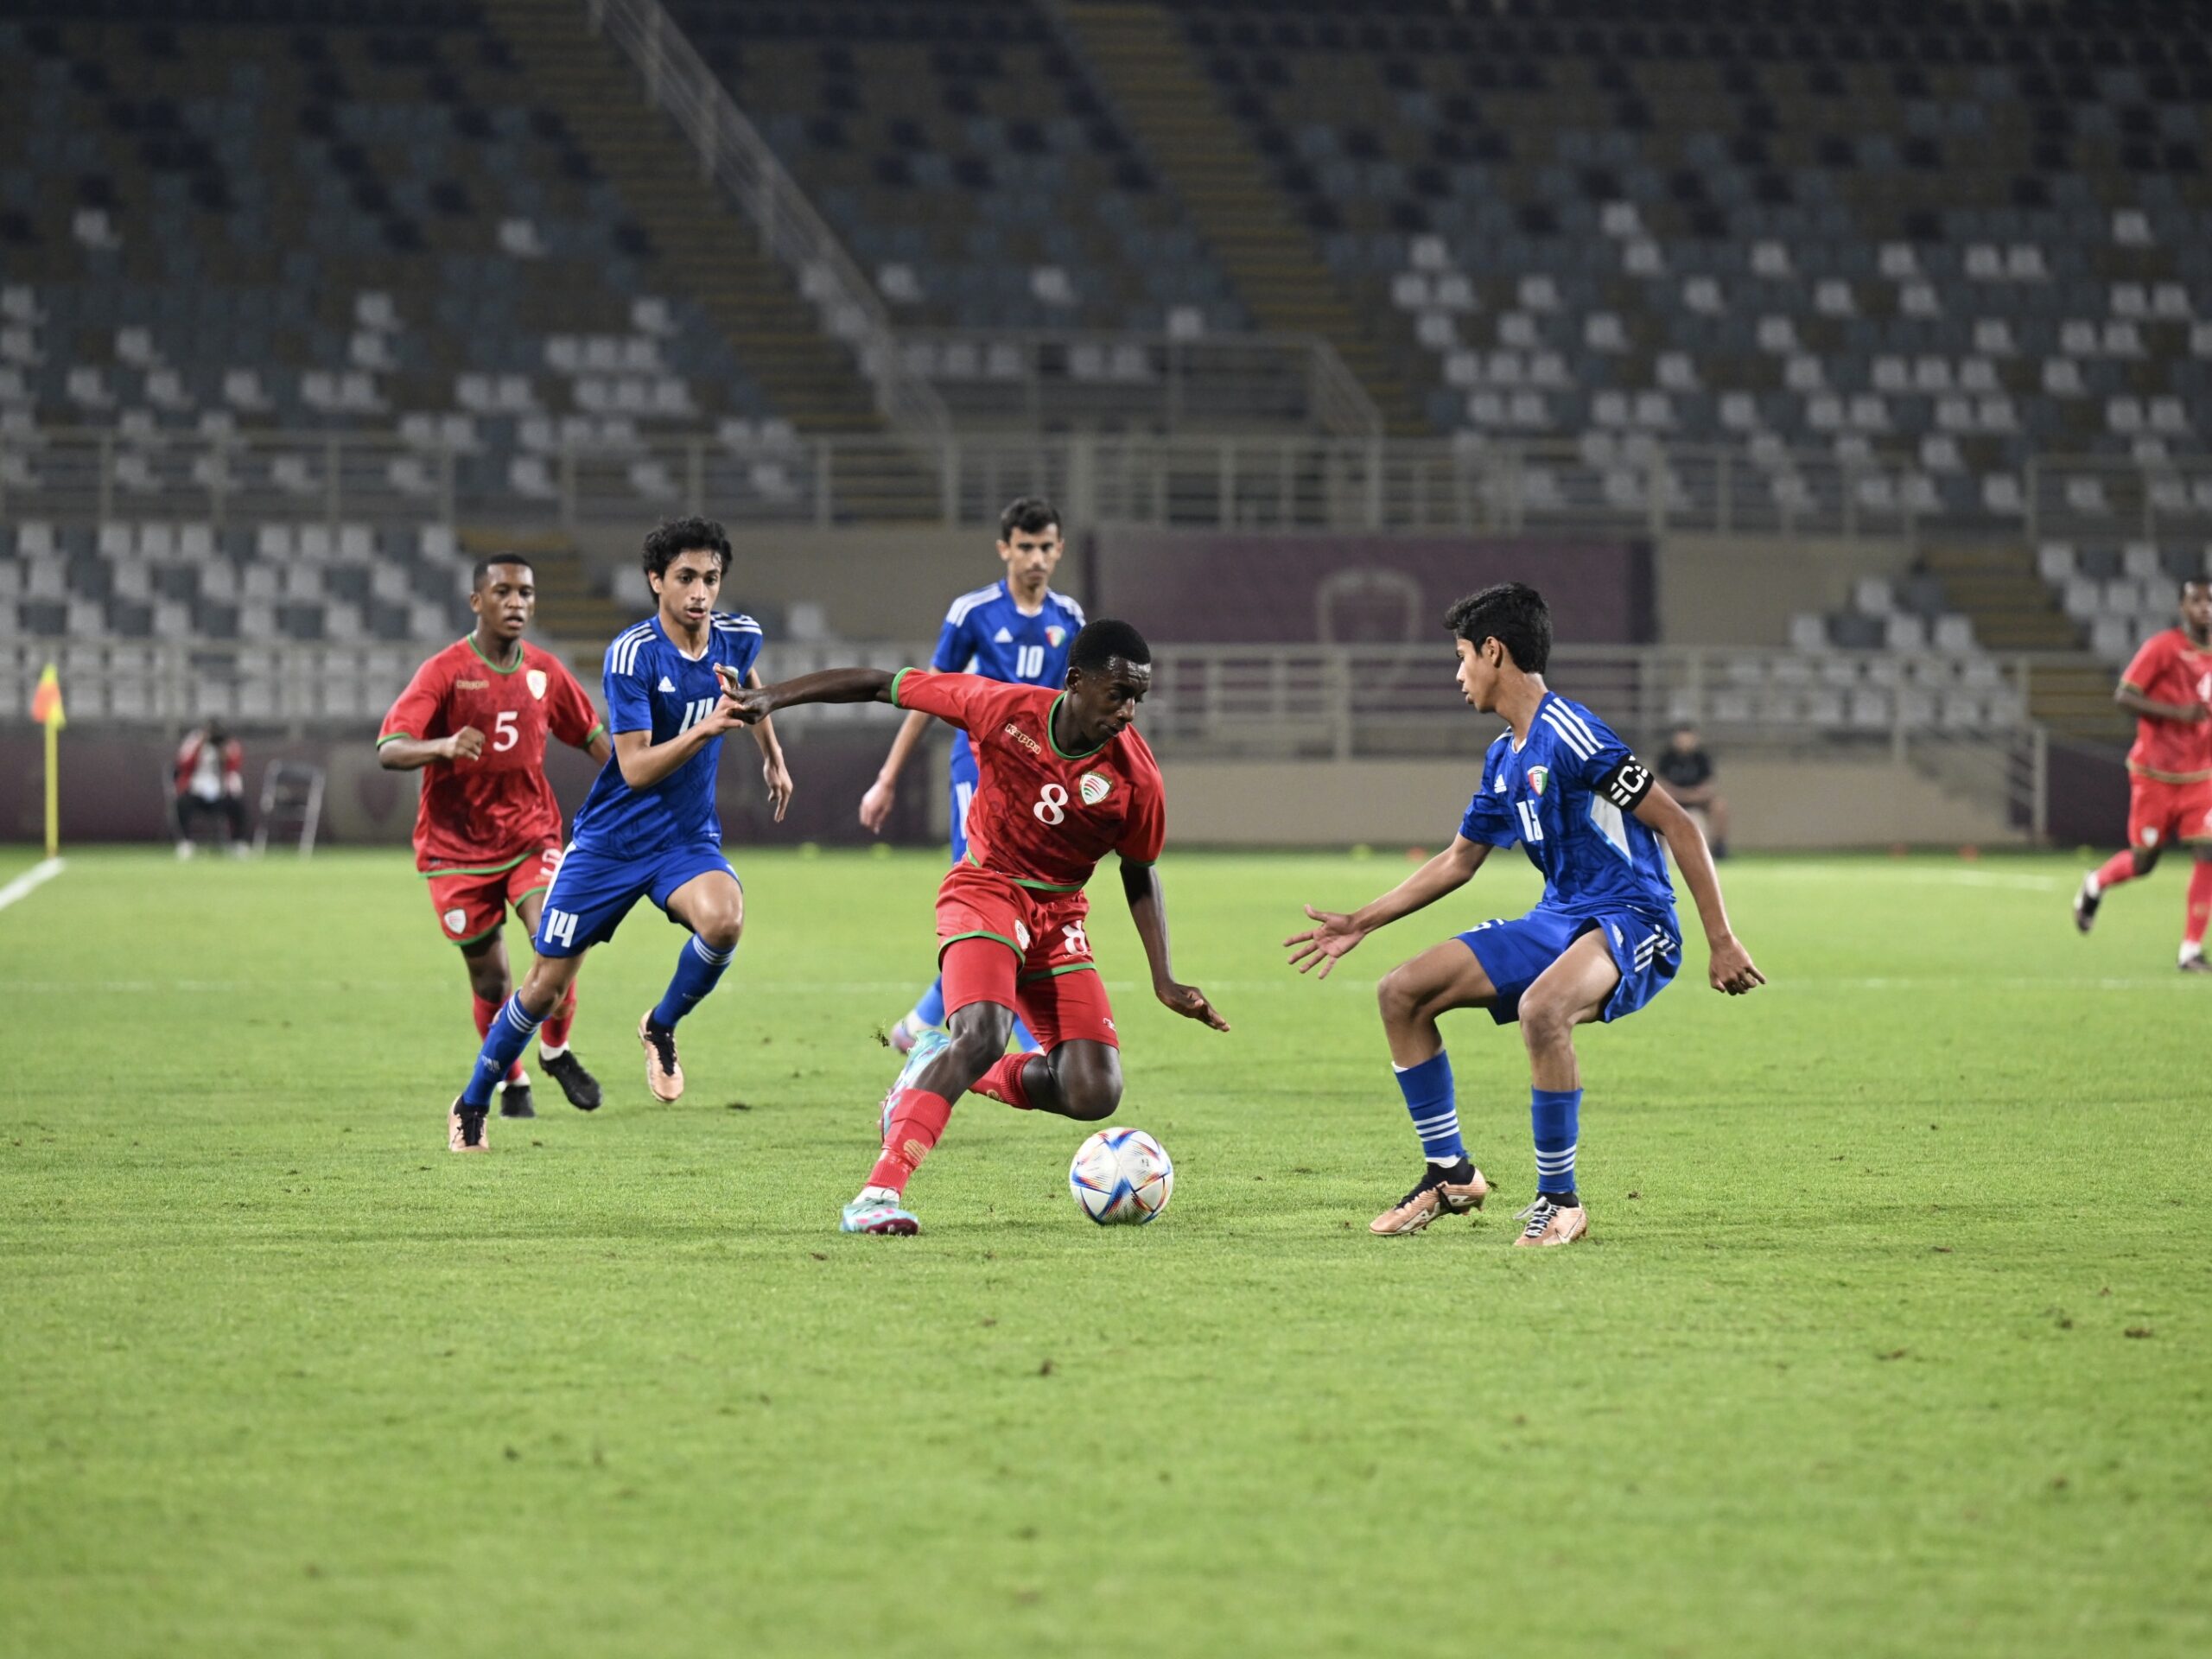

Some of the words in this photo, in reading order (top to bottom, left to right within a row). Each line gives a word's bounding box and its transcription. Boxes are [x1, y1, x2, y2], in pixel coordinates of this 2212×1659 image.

[1015, 645, 1045, 678] 10
[493, 710, 519, 752] 5
[1005, 723, 1041, 754] Kappa
[1033, 783, 1069, 825] 8
[1516, 799, 1544, 842] 15
[544, 908, 579, 948] 14
